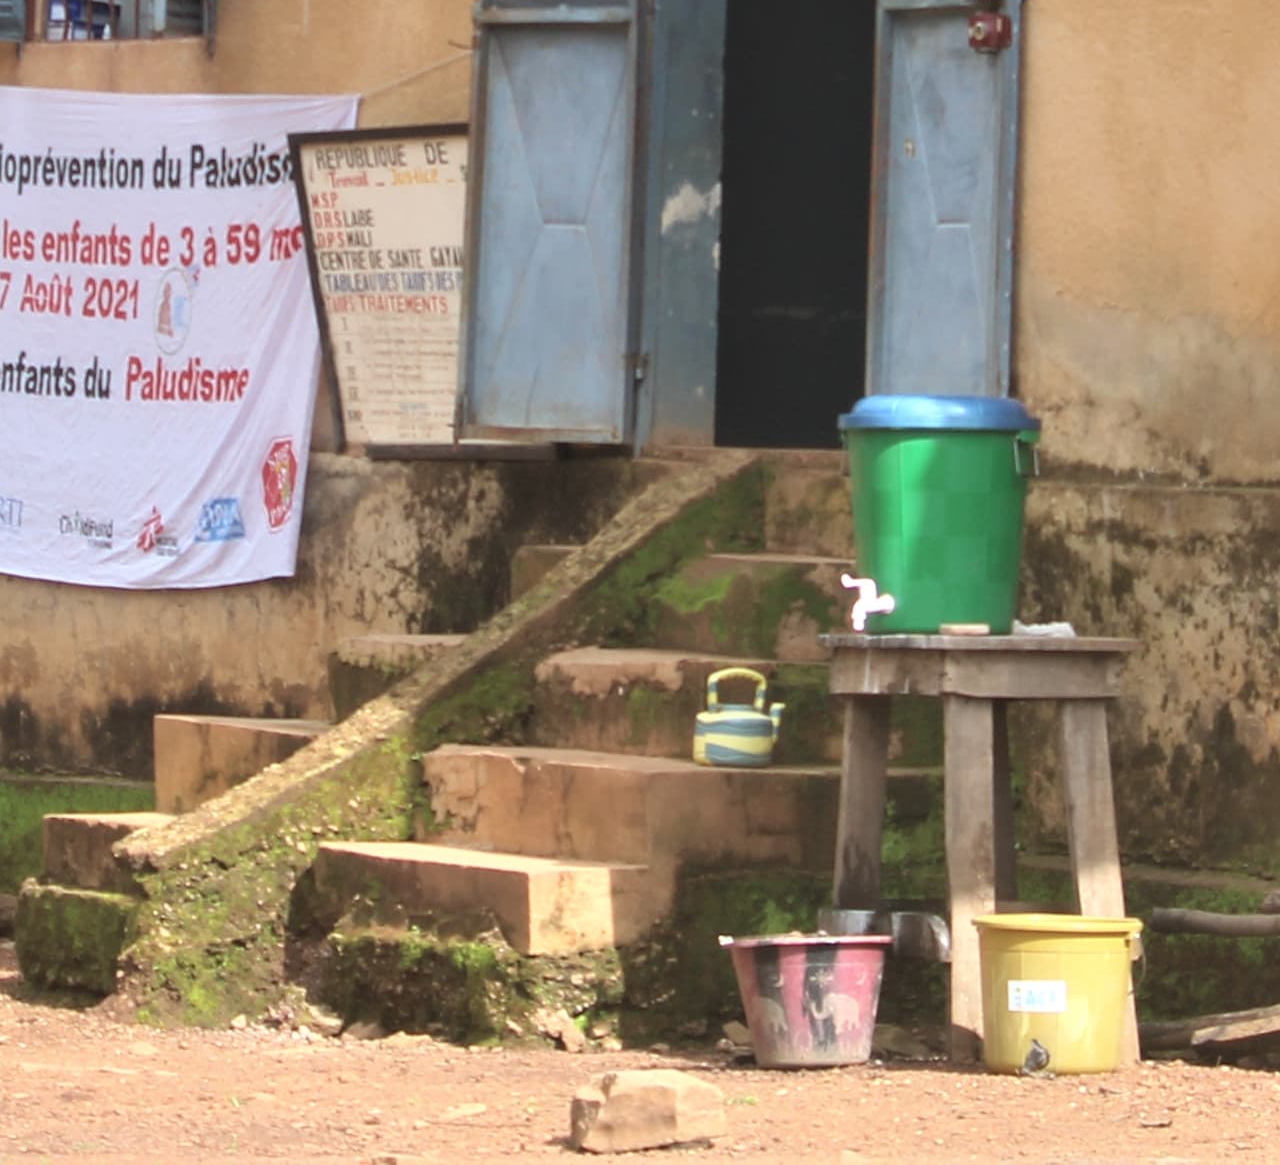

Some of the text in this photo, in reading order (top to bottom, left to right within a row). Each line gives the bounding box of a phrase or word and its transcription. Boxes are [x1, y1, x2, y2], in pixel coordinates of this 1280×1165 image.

[153, 147, 181, 188] du
[315, 140, 449, 171] REPUBLIQUE DE
[3, 219, 35, 262] les
[42, 219, 131, 267] enfants
[140, 222, 169, 266] de
[180, 227, 194, 267] 3
[203, 227, 217, 267] à
[226, 224, 261, 265] 59
[269, 225, 305, 261] mo
[320, 250, 366, 271] CENTRE
[370, 249, 384, 269] DE
[388, 249, 424, 268] SANTE
[20, 273, 72, 316] Août
[82, 277, 139, 321] 2021
[360, 295, 448, 314] TRAITEMENTS
[84, 355, 111, 399] du
[125, 356, 250, 402] Paludisme
